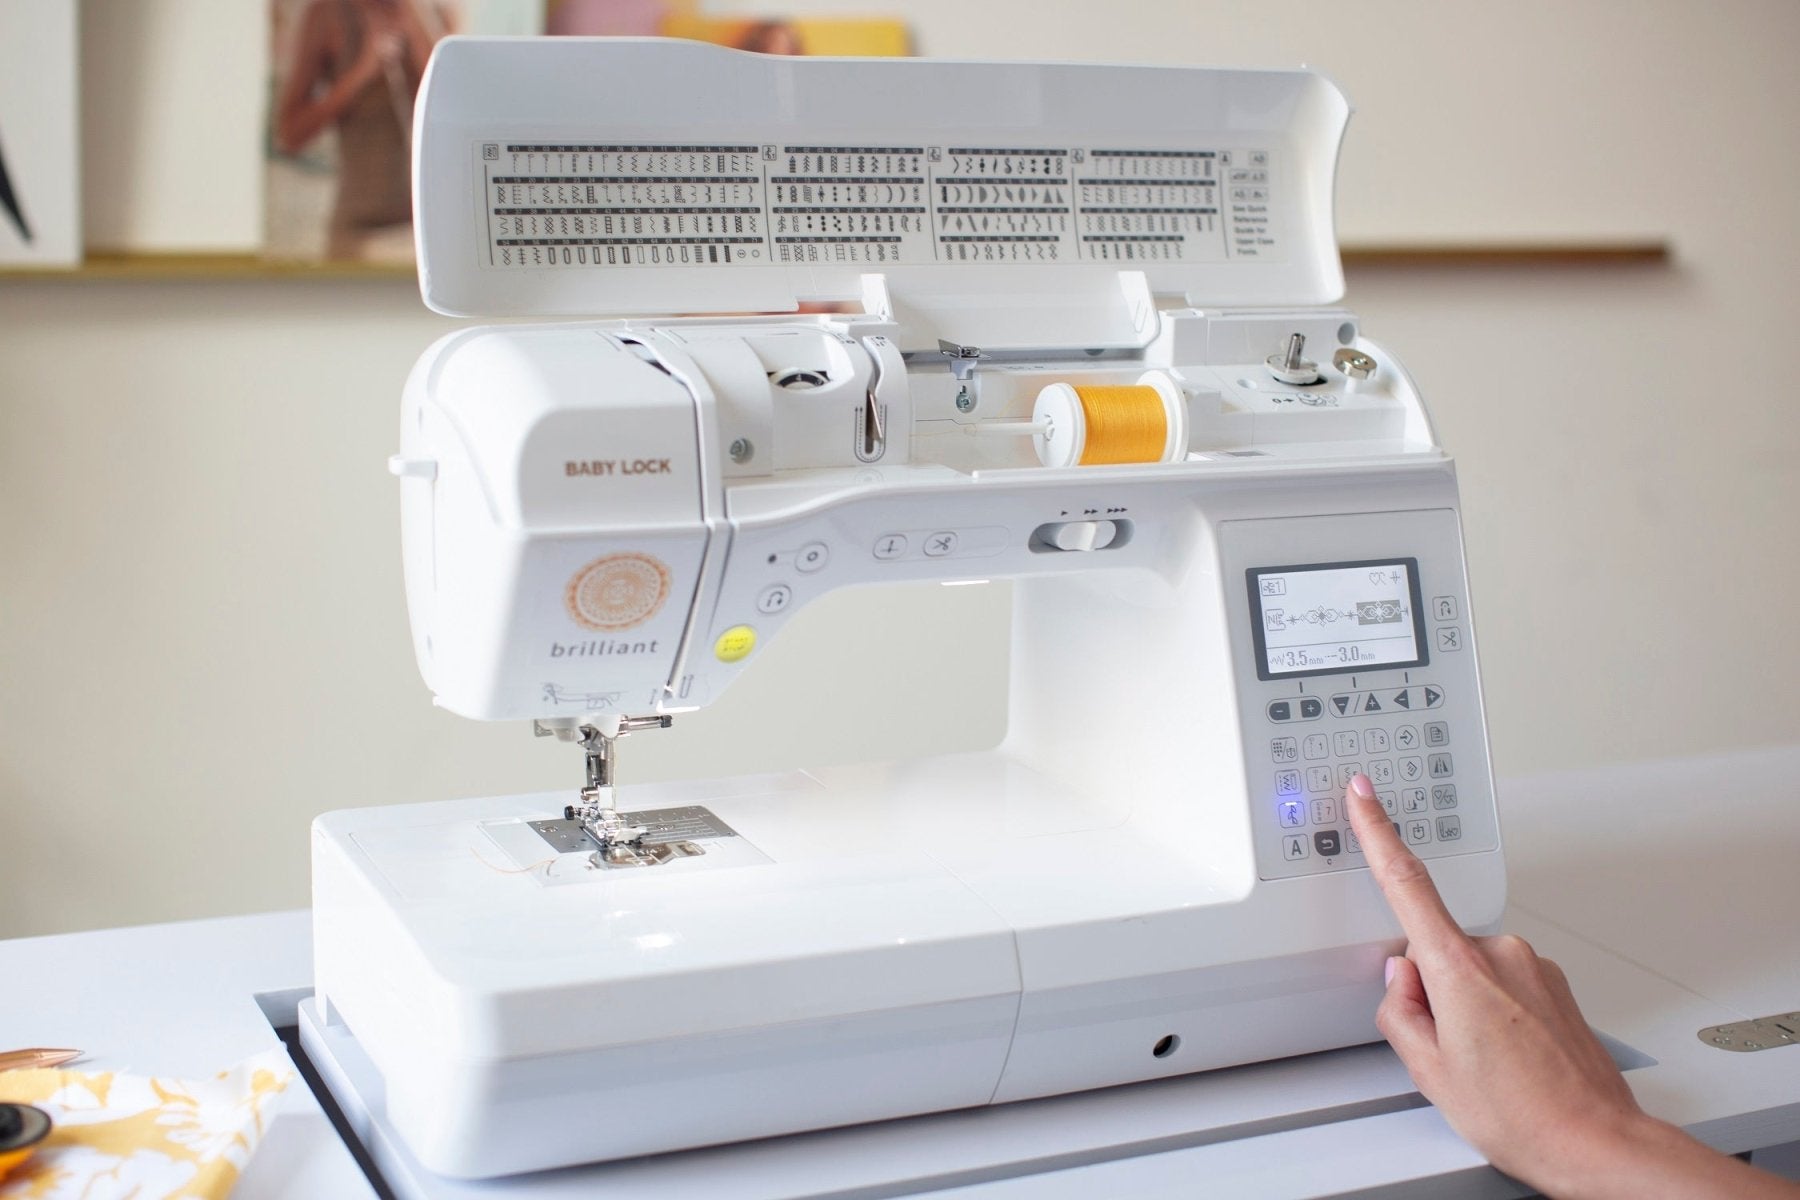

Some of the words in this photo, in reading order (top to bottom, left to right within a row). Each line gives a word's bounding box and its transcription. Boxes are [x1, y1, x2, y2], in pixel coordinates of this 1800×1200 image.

[565, 460, 616, 477] BABY
[621, 458, 672, 475] LOCK
[550, 639, 660, 658] brilliant
[1349, 739, 1355, 748] 2
[1379, 736, 1385, 745] 3
[1383, 767, 1389, 776] 6
[1322, 774, 1328, 783] 4
[1387, 800, 1393, 808] 9
[1325, 806, 1331, 815] 7
[1291, 839, 1302, 856] A
